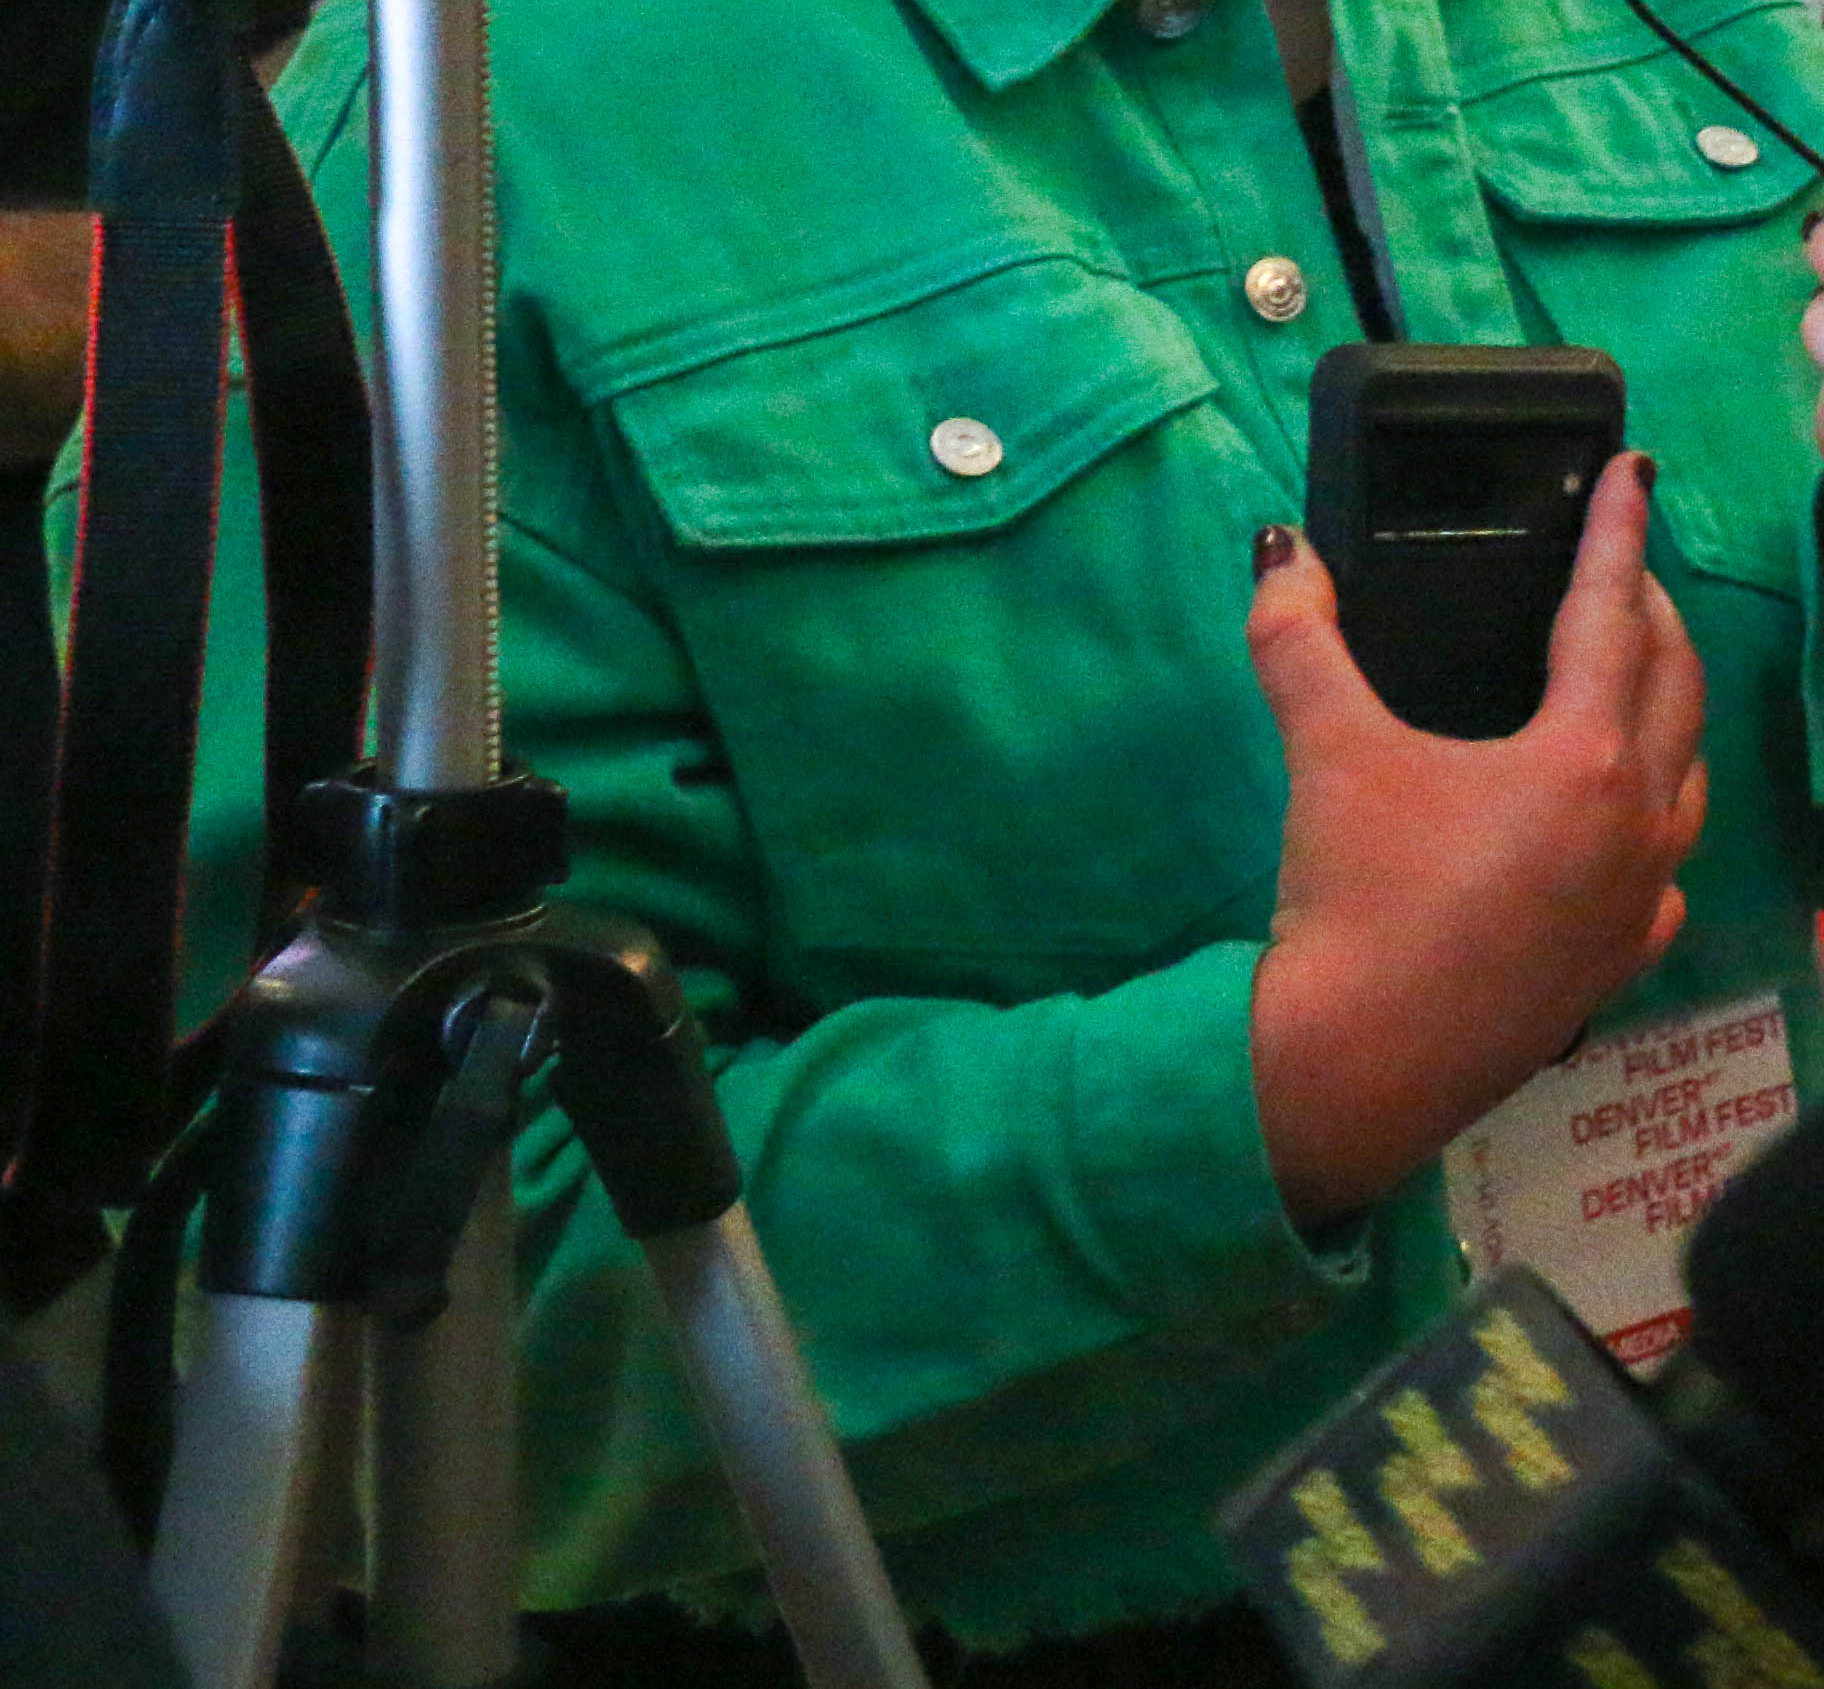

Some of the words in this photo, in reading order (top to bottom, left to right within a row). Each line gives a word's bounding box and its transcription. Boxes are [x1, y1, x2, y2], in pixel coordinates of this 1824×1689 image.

[1624, 1036, 1699, 1084] FILM
[1705, 1009, 1781, 1058] FEST
[1636, 1108, 1709, 1159] FILM
[1714, 1082, 1793, 1133] FEST
